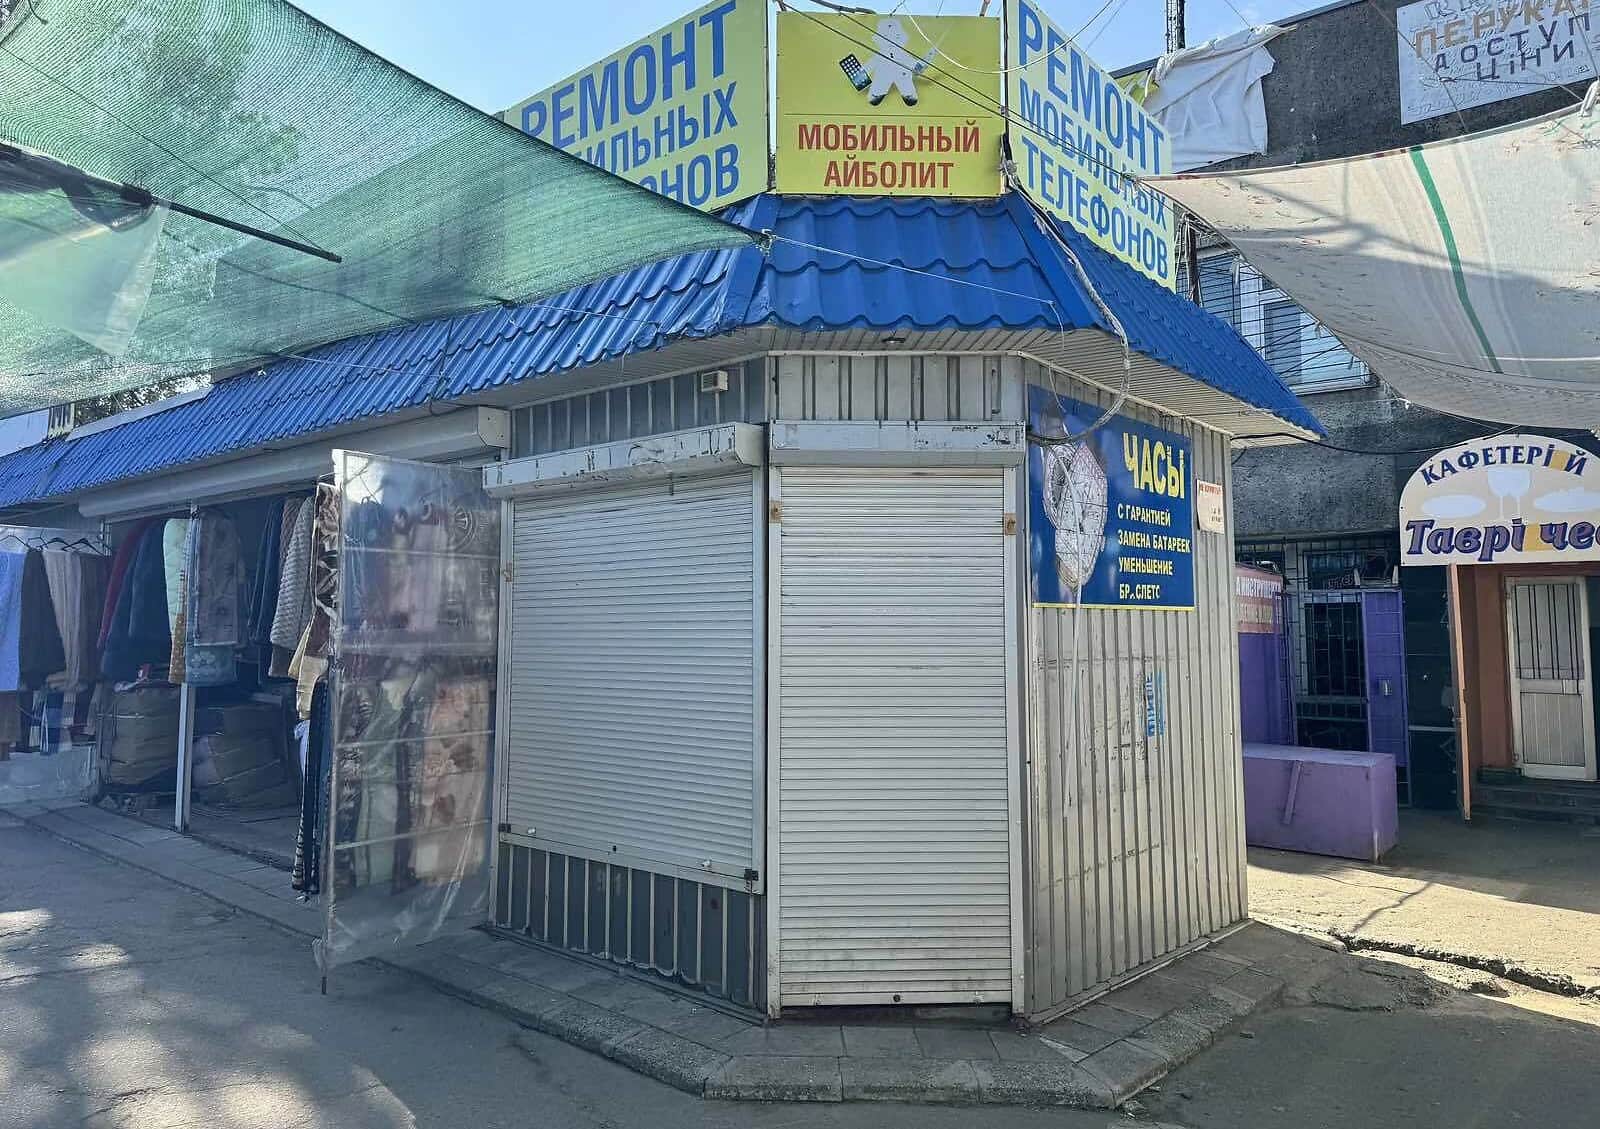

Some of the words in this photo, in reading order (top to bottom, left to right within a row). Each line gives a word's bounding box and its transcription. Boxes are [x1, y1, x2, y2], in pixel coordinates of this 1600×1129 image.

[1415, 0, 1590, 58] ПЕРУКА
[1435, 12, 1590, 73] ДОСТУП
[521, 1, 737, 150] РЕМОНТ
[1018, 0, 1164, 176] РЕМОНТ
[574, 80, 739, 175] ИЛЬНЫХ
[798, 119, 981, 153] МОБИЛЬНЫЙ
[1020, 77, 1167, 232] МОБИЛЬНЫХ
[823, 153, 955, 189] АЙБОЛИТ
[1021, 134, 1169, 281] ТЕЛЕФОНОВ
[1122, 432, 1185, 500] ЧАСЫ
[1117, 503, 1124, 520] С
[1125, 504, 1171, 528] ГАРАНТИЕЙ
[1117, 529, 1151, 549] ЗАМЕНА
[1152, 533, 1191, 554] БАТАРЕЕК
[1118, 557, 1173, 576] УМЕНЬШЕНИЕ
